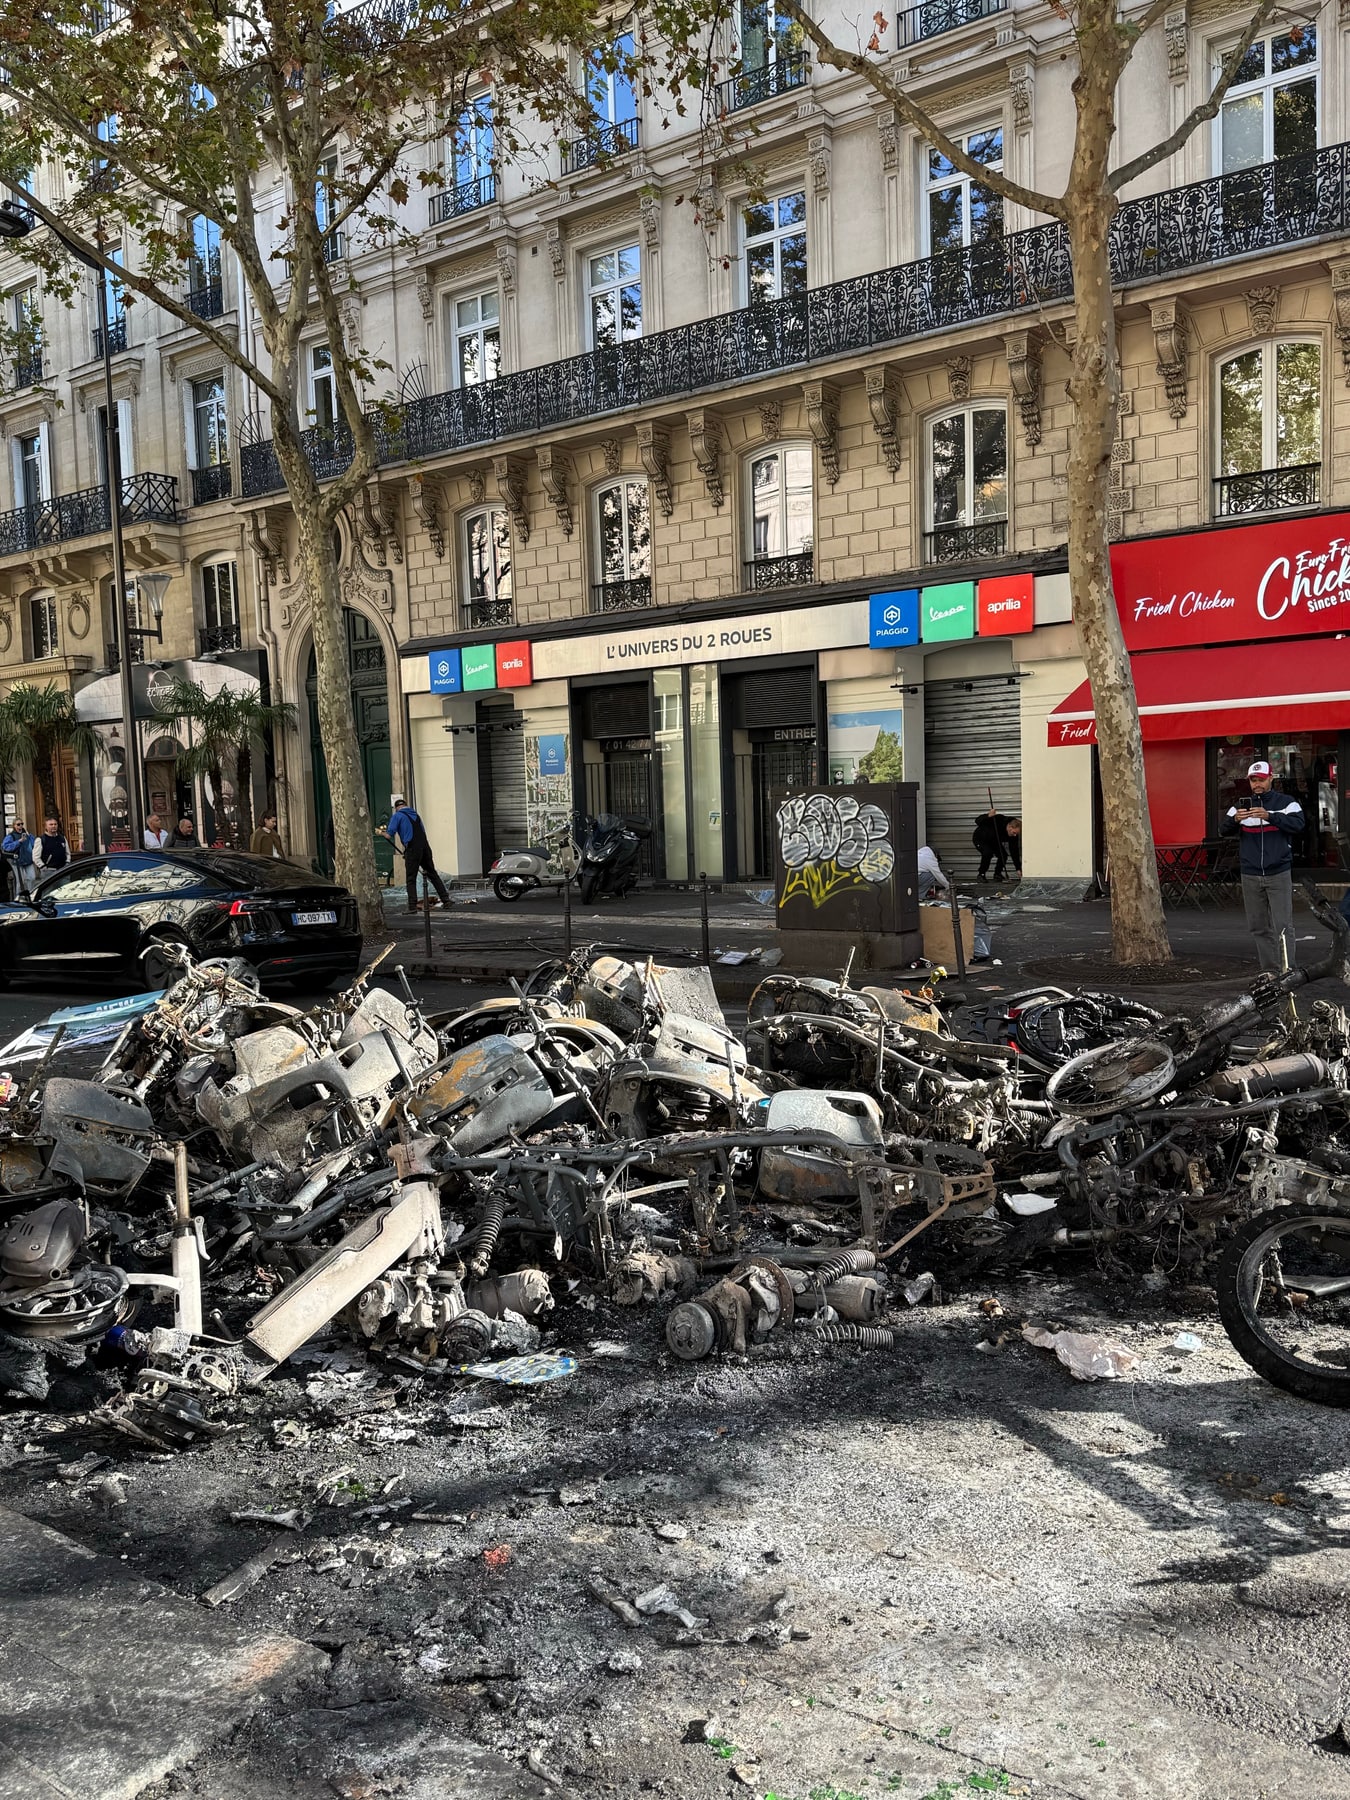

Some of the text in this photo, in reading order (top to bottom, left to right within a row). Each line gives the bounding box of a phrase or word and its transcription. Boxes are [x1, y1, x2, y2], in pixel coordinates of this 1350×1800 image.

[1295, 550, 1329, 575] Euro
[987, 598, 1021, 614] aprilia
[1134, 590, 1235, 622] Fried Chicken
[1307, 595, 1337, 613] Since
[929, 605, 967, 622] Vespa
[682, 635, 703, 650] DU
[707, 634, 716, 648] 2
[720, 627, 772, 646] ROUES
[875, 627, 909, 636] PIAGGIO
[465, 663, 489, 675] Vespa
[502, 658, 523, 670] aprilia
[1060, 722, 1093, 741] Fried
